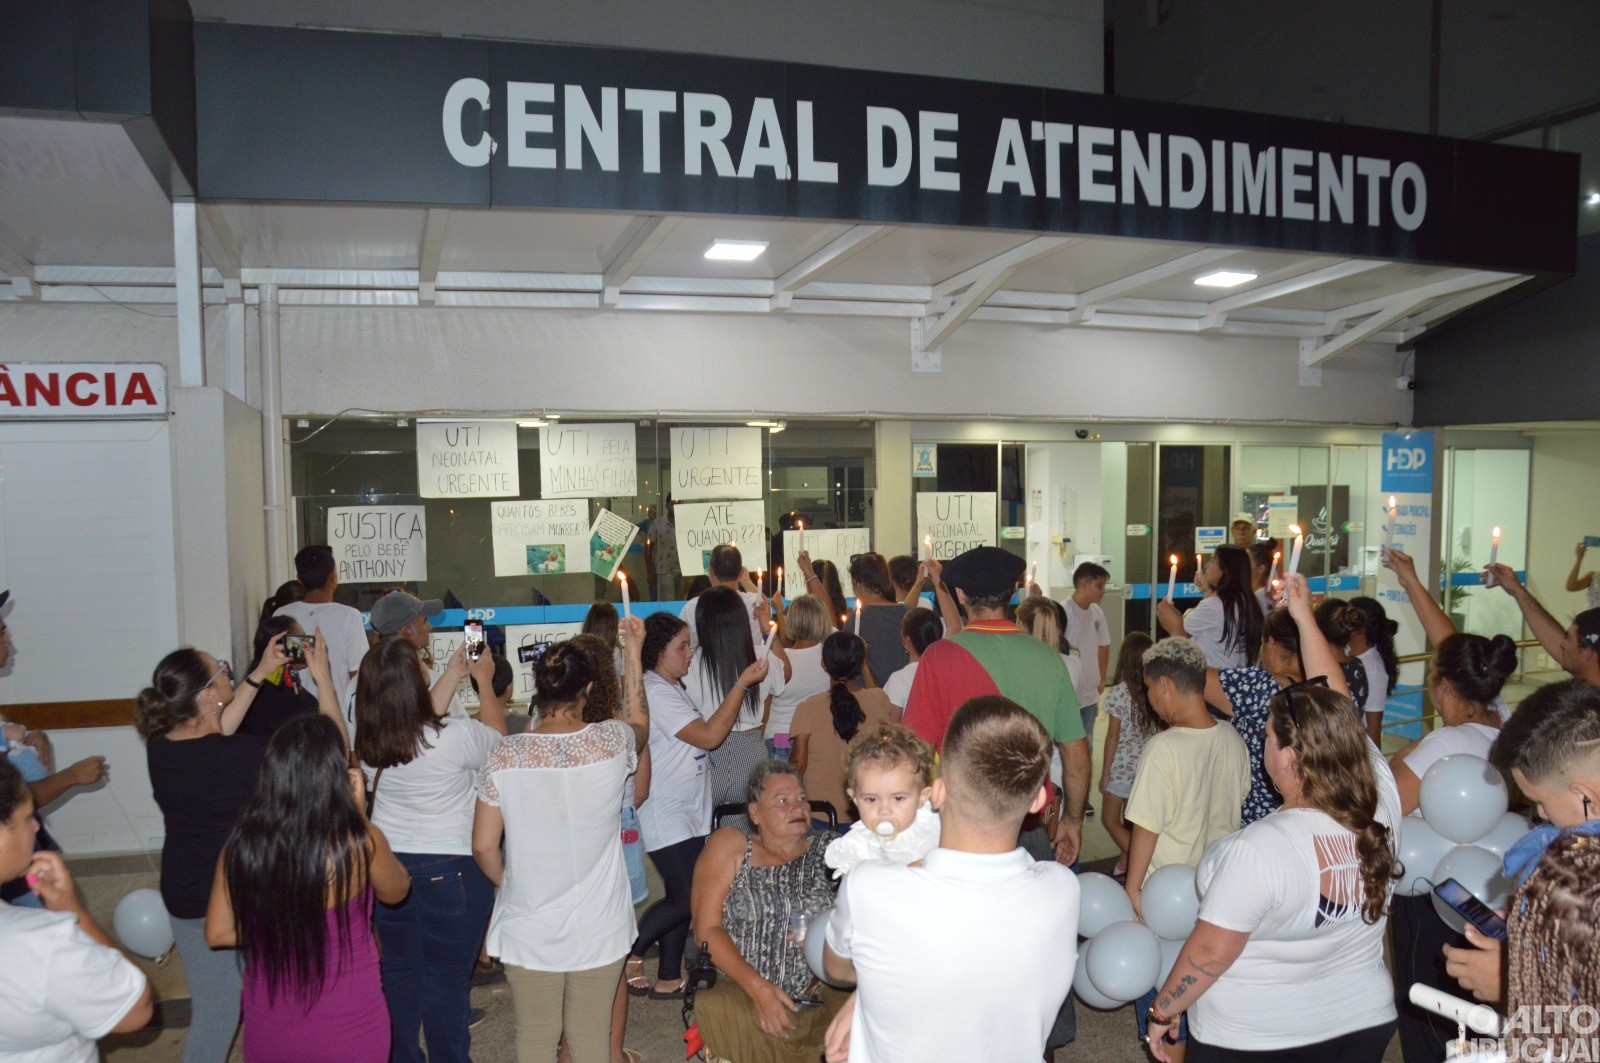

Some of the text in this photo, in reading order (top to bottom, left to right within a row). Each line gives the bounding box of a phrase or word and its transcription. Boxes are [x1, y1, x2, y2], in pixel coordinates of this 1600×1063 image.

[442, 77, 1428, 232] CENTRAL DE ATENDIMENTO
[445, 426, 481, 447] UTI
[546, 428, 631, 456] UTI PELA
[680, 428, 729, 460] UTI
[432, 450, 502, 468] NEONATAL
[1386, 447, 1427, 471] HDP
[437, 472, 511, 494] URGENTE
[549, 465, 636, 492] MINHA FILHA
[678, 466, 758, 489] URGENTE
[497, 504, 542, 521] QUANTOS
[703, 501, 735, 526] ATÉ
[936, 494, 974, 521] UTI
[334, 512, 424, 544] JUSTIÇA
[498, 523, 545, 537] PRECISAM
[928, 522, 983, 540] NEONATAL
[345, 540, 410, 558] PELO BEBÊ
[339, 559, 407, 580] ANTHONY
[467, 609, 496, 622] HDP
